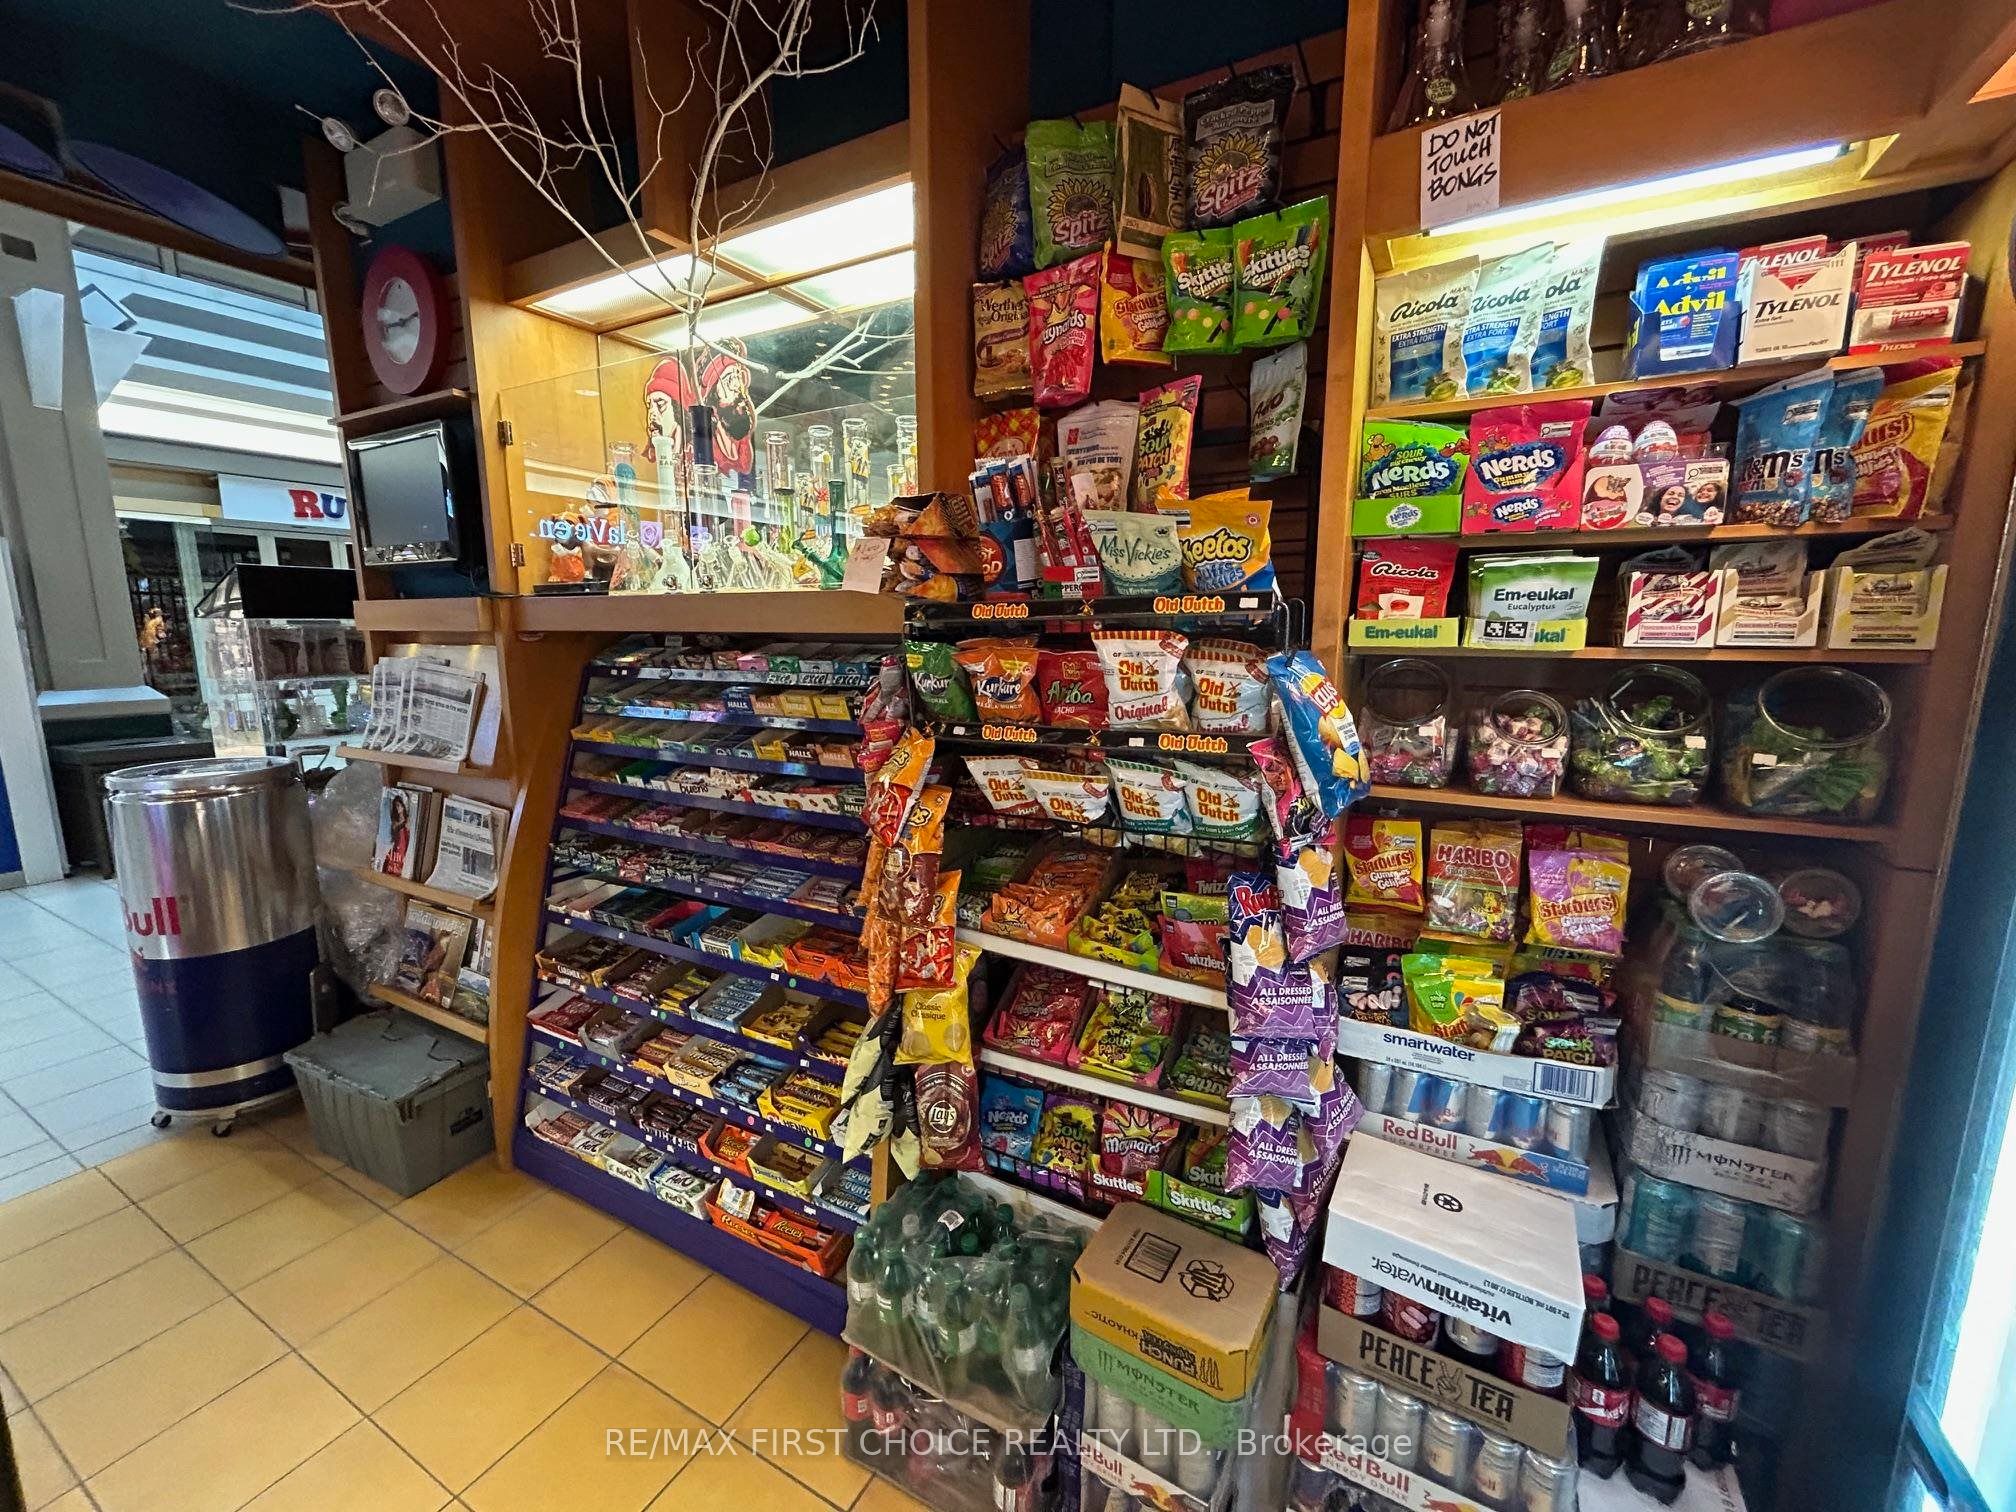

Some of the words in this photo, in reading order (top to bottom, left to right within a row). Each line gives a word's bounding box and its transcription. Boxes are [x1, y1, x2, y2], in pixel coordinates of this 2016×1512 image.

[1428, 129, 1459, 157] DO
[1465, 115, 1498, 143] NOT
[1428, 135, 1492, 176] TOUCH
[1197, 163, 1262, 212] Spitz
[1427, 162, 1498, 201] BONGS
[1242, 244, 1311, 286] Skittles
[1866, 256, 1962, 283] TYLENOL
[1390, 293, 1459, 323] Ricola
[1655, 289, 1726, 317] Advil
[1754, 293, 1843, 319] TYLENOL
[1391, 331, 1411, 343] EXTRA
[1412, 324, 1447, 339] STRENGTH
[1480, 318, 1520, 334] STRENGTH
[1396, 449, 1423, 460] SOUR
[289, 489, 347, 520] RU
[1100, 535, 1124, 564] Miss
[1125, 537, 1172, 567] Vickie's
[1370, 562, 1439, 580] Ricola
[1154, 596, 1180, 613] Old
[1182, 596, 1226, 613] Dutch
[1494, 587, 1575, 603] Em-eukal
[972, 603, 993, 619] Old
[995, 602, 1028, 619] Dutch
[1507, 603, 1556, 613] Eucalyptus
[1365, 624, 1439, 640] Em-eukal
[1118, 659, 1144, 677] Old
[976, 676, 1022, 697] Kurkure
[1119, 677, 1159, 693] Dutch
[1199, 678, 1225, 697] Old
[728, 701, 748, 709] HALLS
[1114, 696, 1169, 721] Original
[1200, 696, 1237, 714] Dutch
[982, 725, 1002, 741] Old
[1004, 726, 1037, 743] Dutch
[1158, 733, 1184, 751] Old
[1186, 734, 1229, 753] Dutch
[789, 750, 812, 759] HALLS
[988, 777, 1010, 792] Old
[991, 790, 1028, 802] Dutch
[1050, 797, 1072, 811] Old
[1121, 786, 1144, 803] Old
[1196, 787, 1222, 806] Old
[1124, 800, 1161, 819] Dutch
[1198, 801, 1240, 822] Dutch
[1353, 849, 1417, 876] Starburst
[1437, 843, 1512, 869] HARIBO
[1316, 906, 1329, 917] ALL
[1182, 951, 1227, 972] Twizzlers
[1260, 987, 1278, 998] ALL
[1279, 986, 1312, 996] DRESSED
[915, 1001, 942, 1013] Classic
[1257, 1052, 1275, 1063] ALL
[1276, 1052, 1307, 1063] DRESSED
[1383, 1034, 1475, 1062] smartwater
[1543, 1049, 1596, 1065] PATCH
[1331, 1106, 1342, 1119] ALL
[1382, 1118, 1418, 1141] Red
[1421, 1126, 1459, 1151] Bull
[1258, 1141, 1275, 1153] ALL
[1275, 1144, 1298, 1156] DRESS
[1093, 1173, 1144, 1196] Skittles
[1170, 1190, 1233, 1220] Skittles
[773, 1220, 804, 1240] Reese's
[1360, 1330, 1437, 1390] PEACE
[1465, 1373, 1516, 1424] TEA
[1091, 1451, 1123, 1478] Bull
[1321, 1443, 1363, 1472] Red
[1365, 1456, 1410, 1492] Bull
